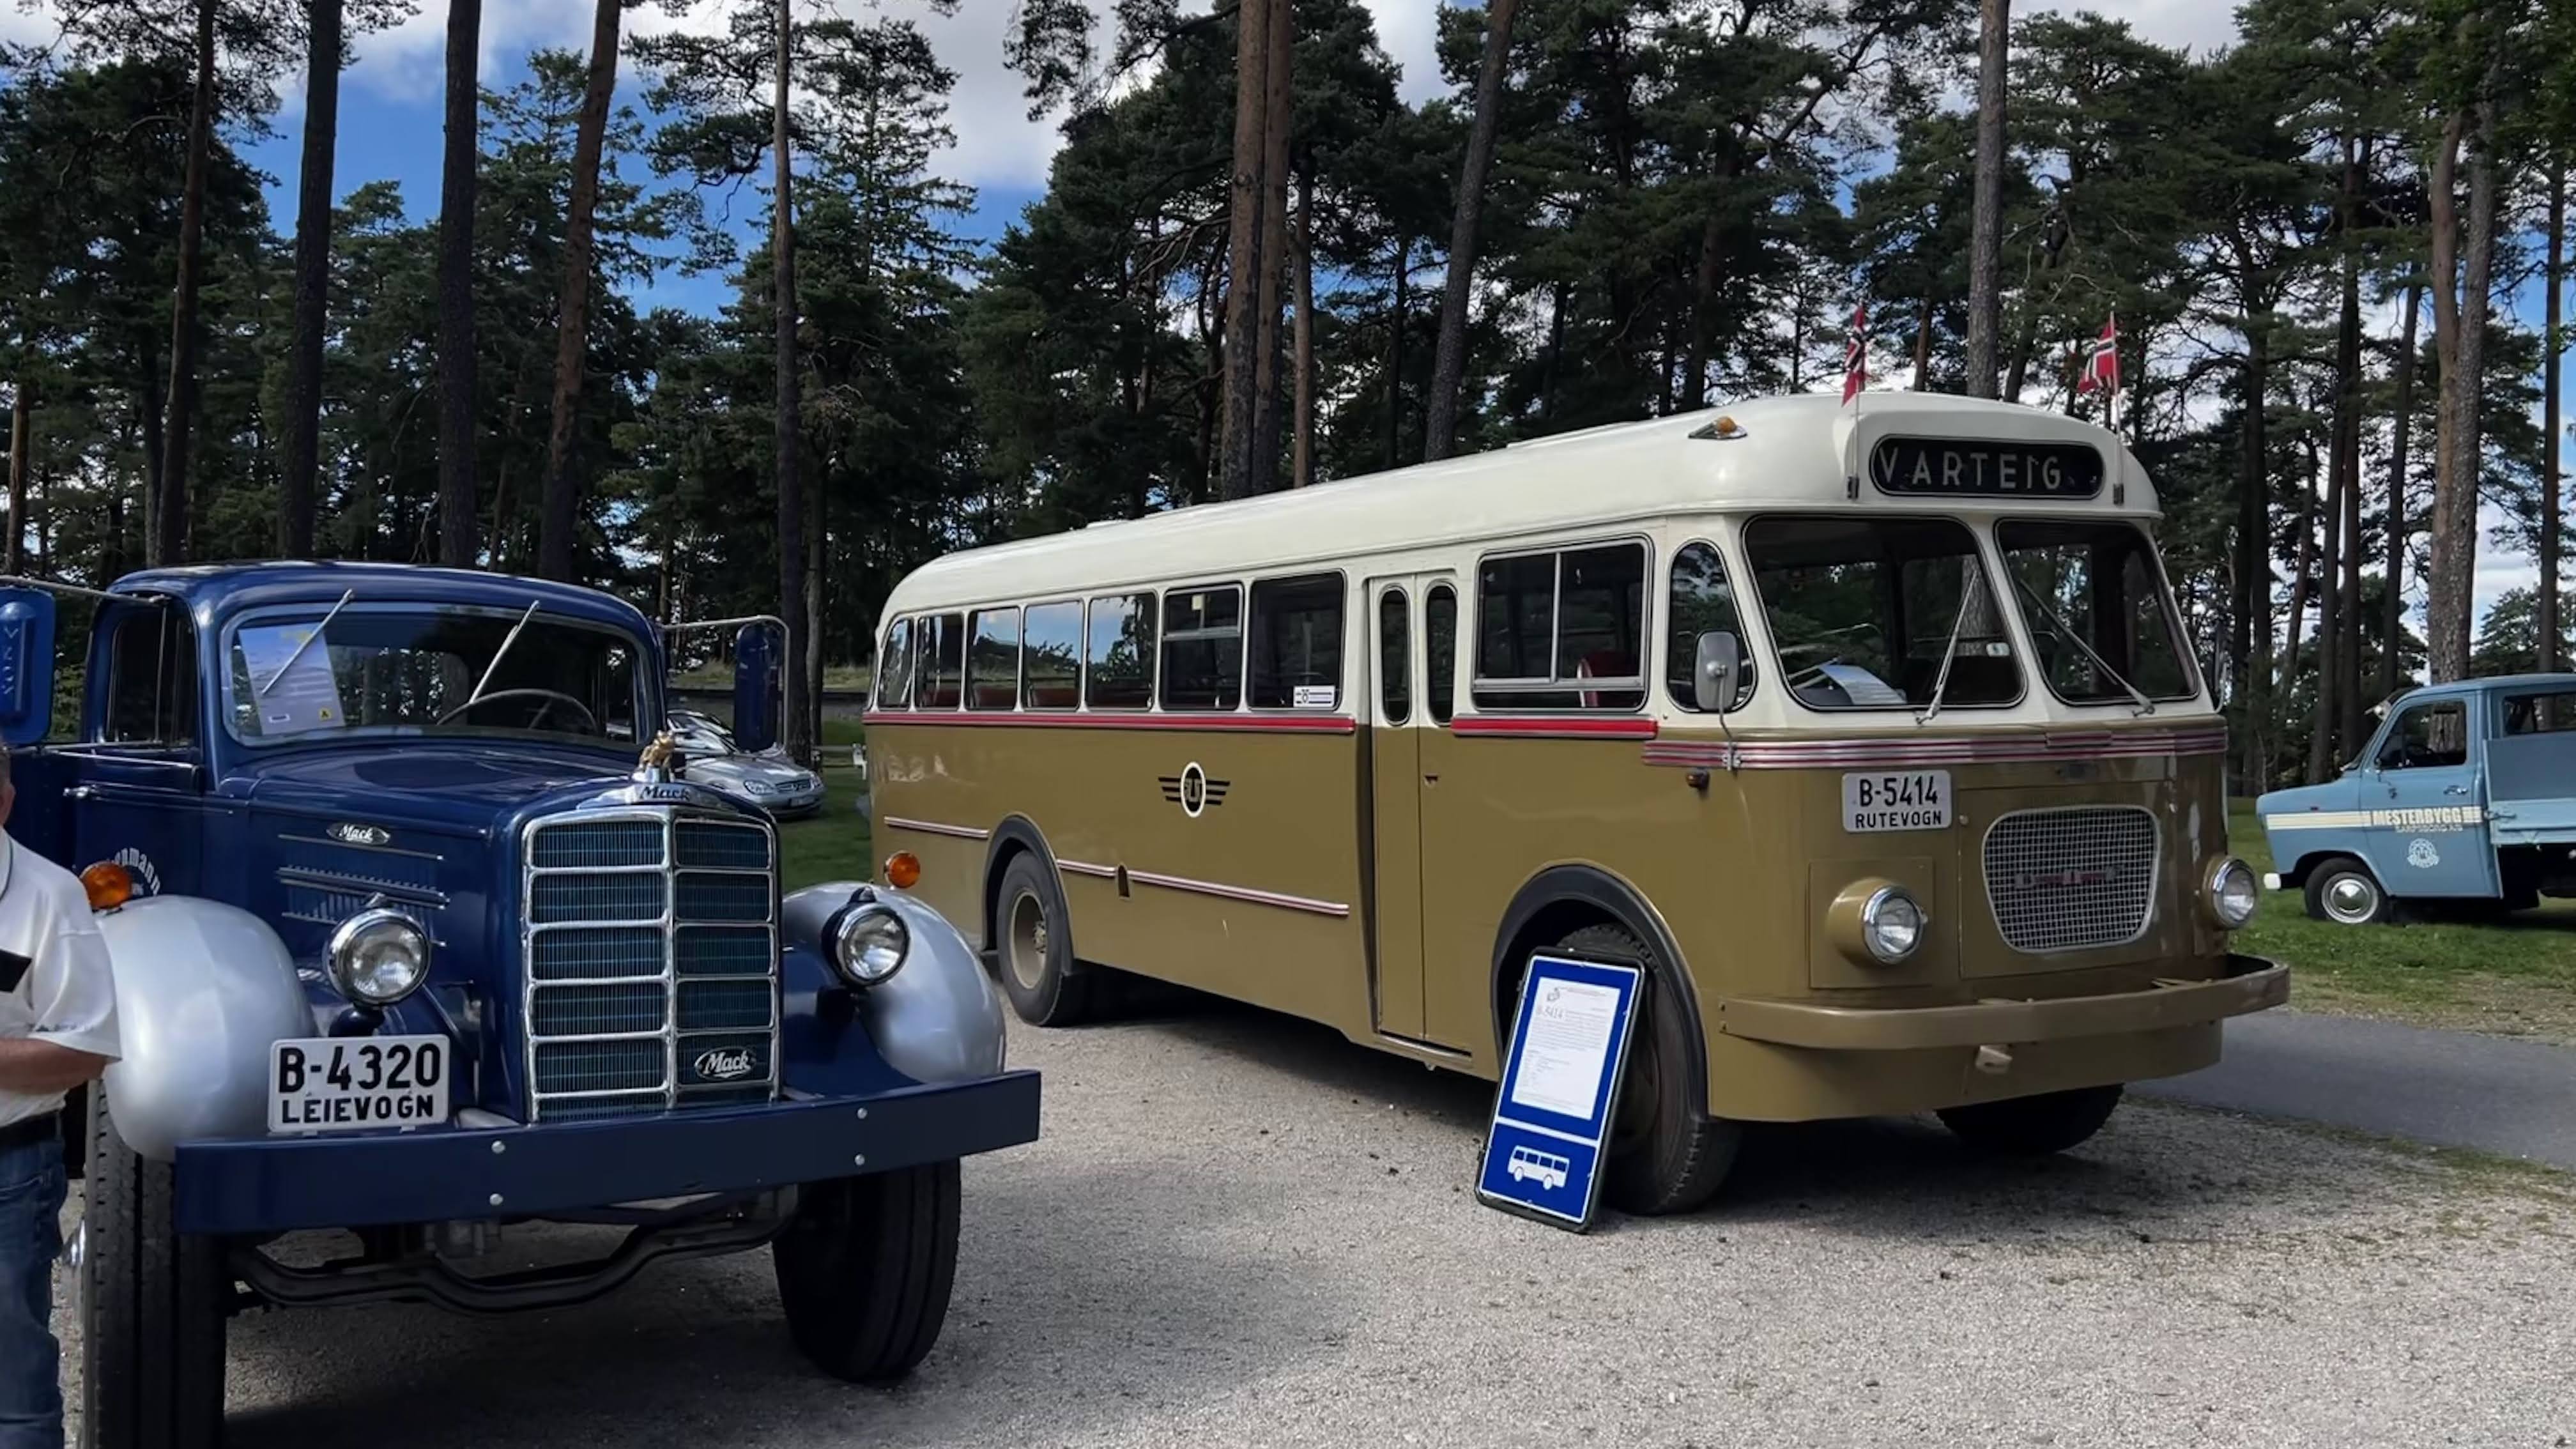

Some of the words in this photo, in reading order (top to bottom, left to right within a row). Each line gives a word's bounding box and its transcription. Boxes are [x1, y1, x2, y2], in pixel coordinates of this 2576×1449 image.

[1878, 447, 2062, 490] VARTEIG
[640, 786, 691, 802] Mack
[1859, 775, 1938, 808] B-5414
[1855, 810, 1942, 829] RUTEVOGN
[2372, 807, 2462, 826] MESTERBYGG
[339, 824, 374, 843] Mack
[278, 1043, 441, 1094] B-4320
[703, 1050, 752, 1075] Mack
[282, 1094, 434, 1124] LEIEVOGN
